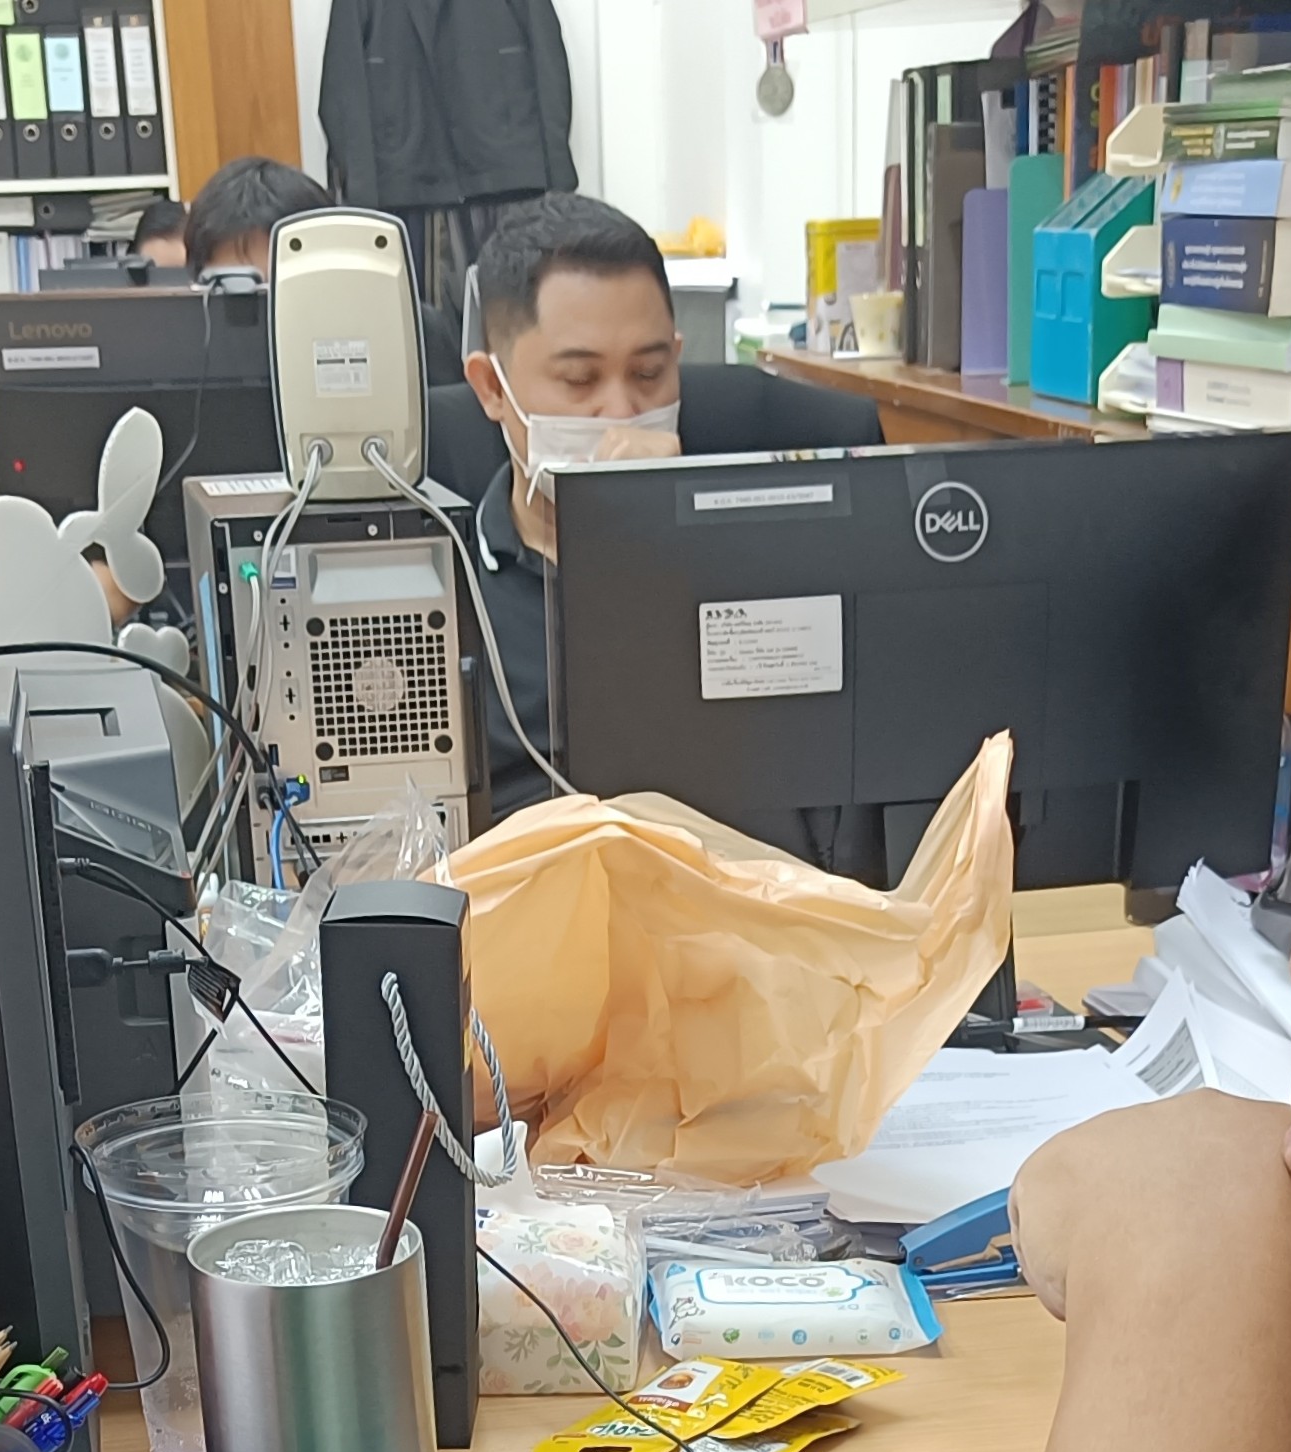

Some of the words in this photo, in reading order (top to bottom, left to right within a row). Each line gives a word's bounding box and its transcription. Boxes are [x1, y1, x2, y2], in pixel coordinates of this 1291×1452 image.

[8, 321, 93, 340] Lenovo
[925, 510, 981, 534] DELL
[723, 1272, 826, 1288] KOCO
